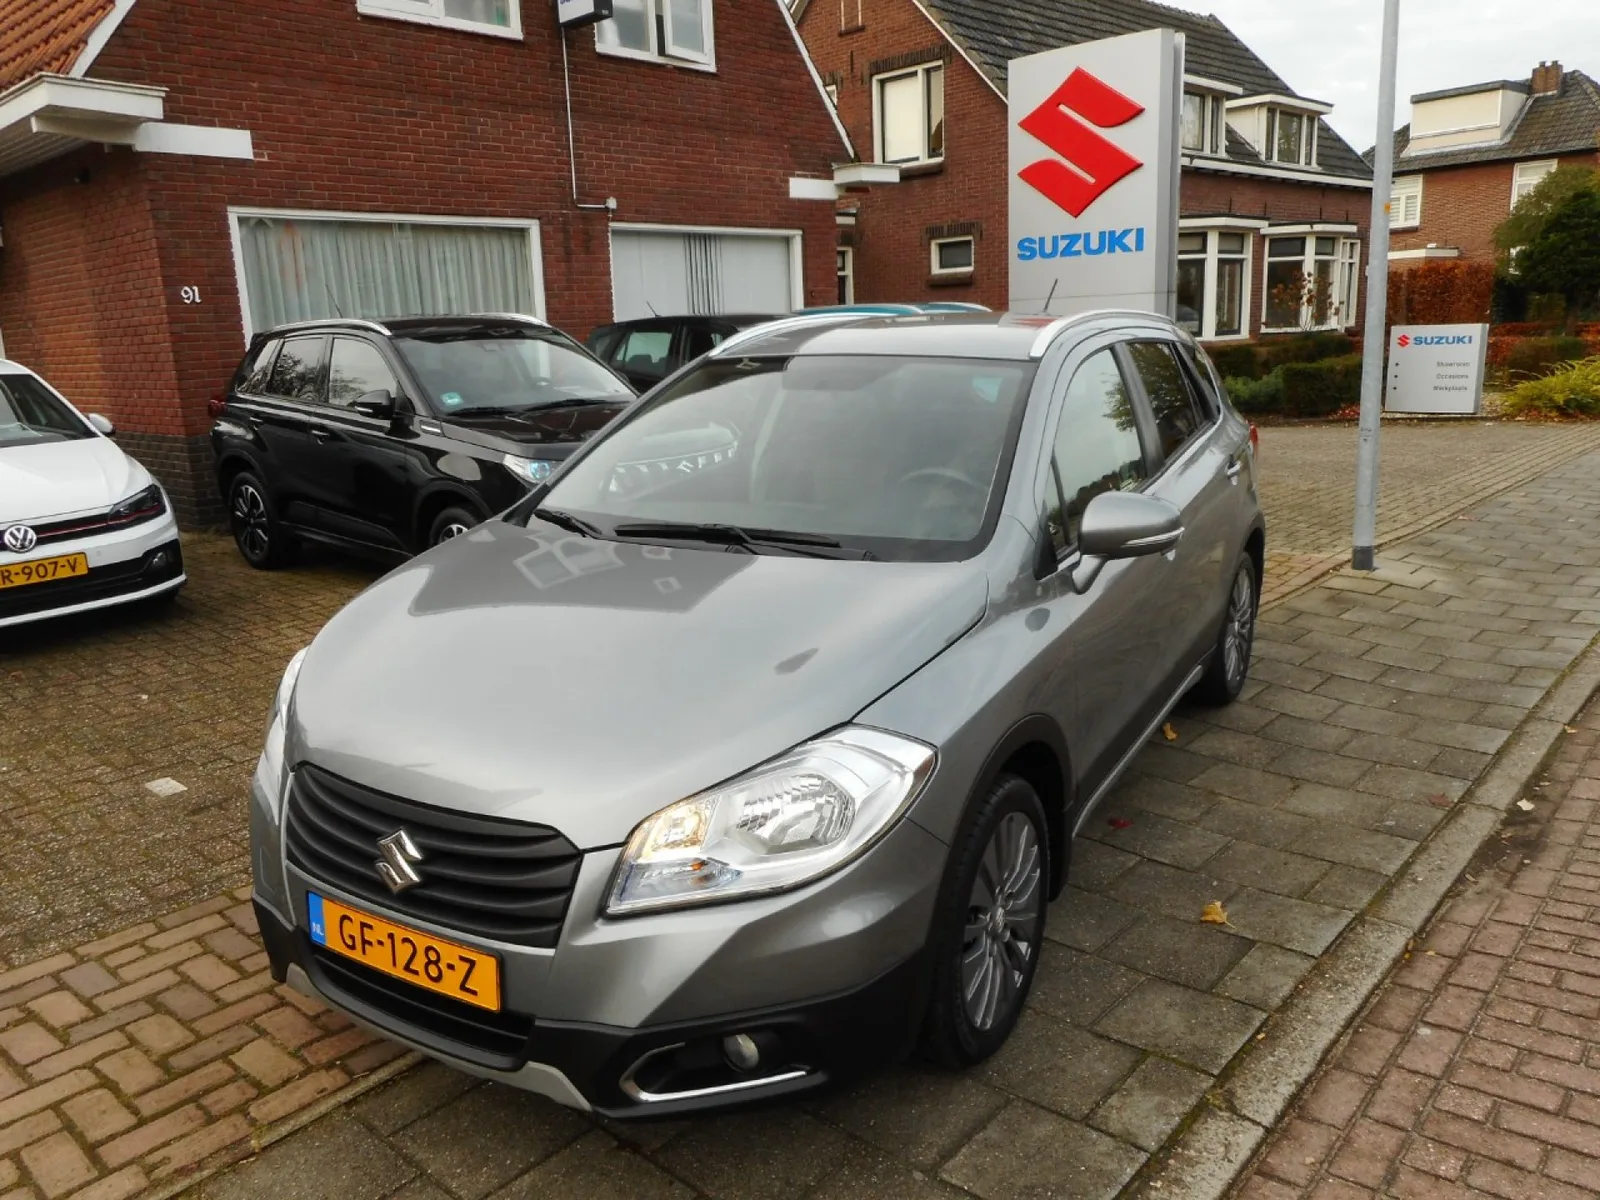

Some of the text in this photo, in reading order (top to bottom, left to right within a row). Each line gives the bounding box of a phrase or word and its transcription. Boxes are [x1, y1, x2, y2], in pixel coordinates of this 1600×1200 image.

[1017, 227, 1145, 261] SUZUKI
[181, 286, 202, 303] 91
[1413, 335, 1473, 346] SUZUKI
[312, 922, 325, 936] NL
[339, 914, 478, 997] GF-128-Z
